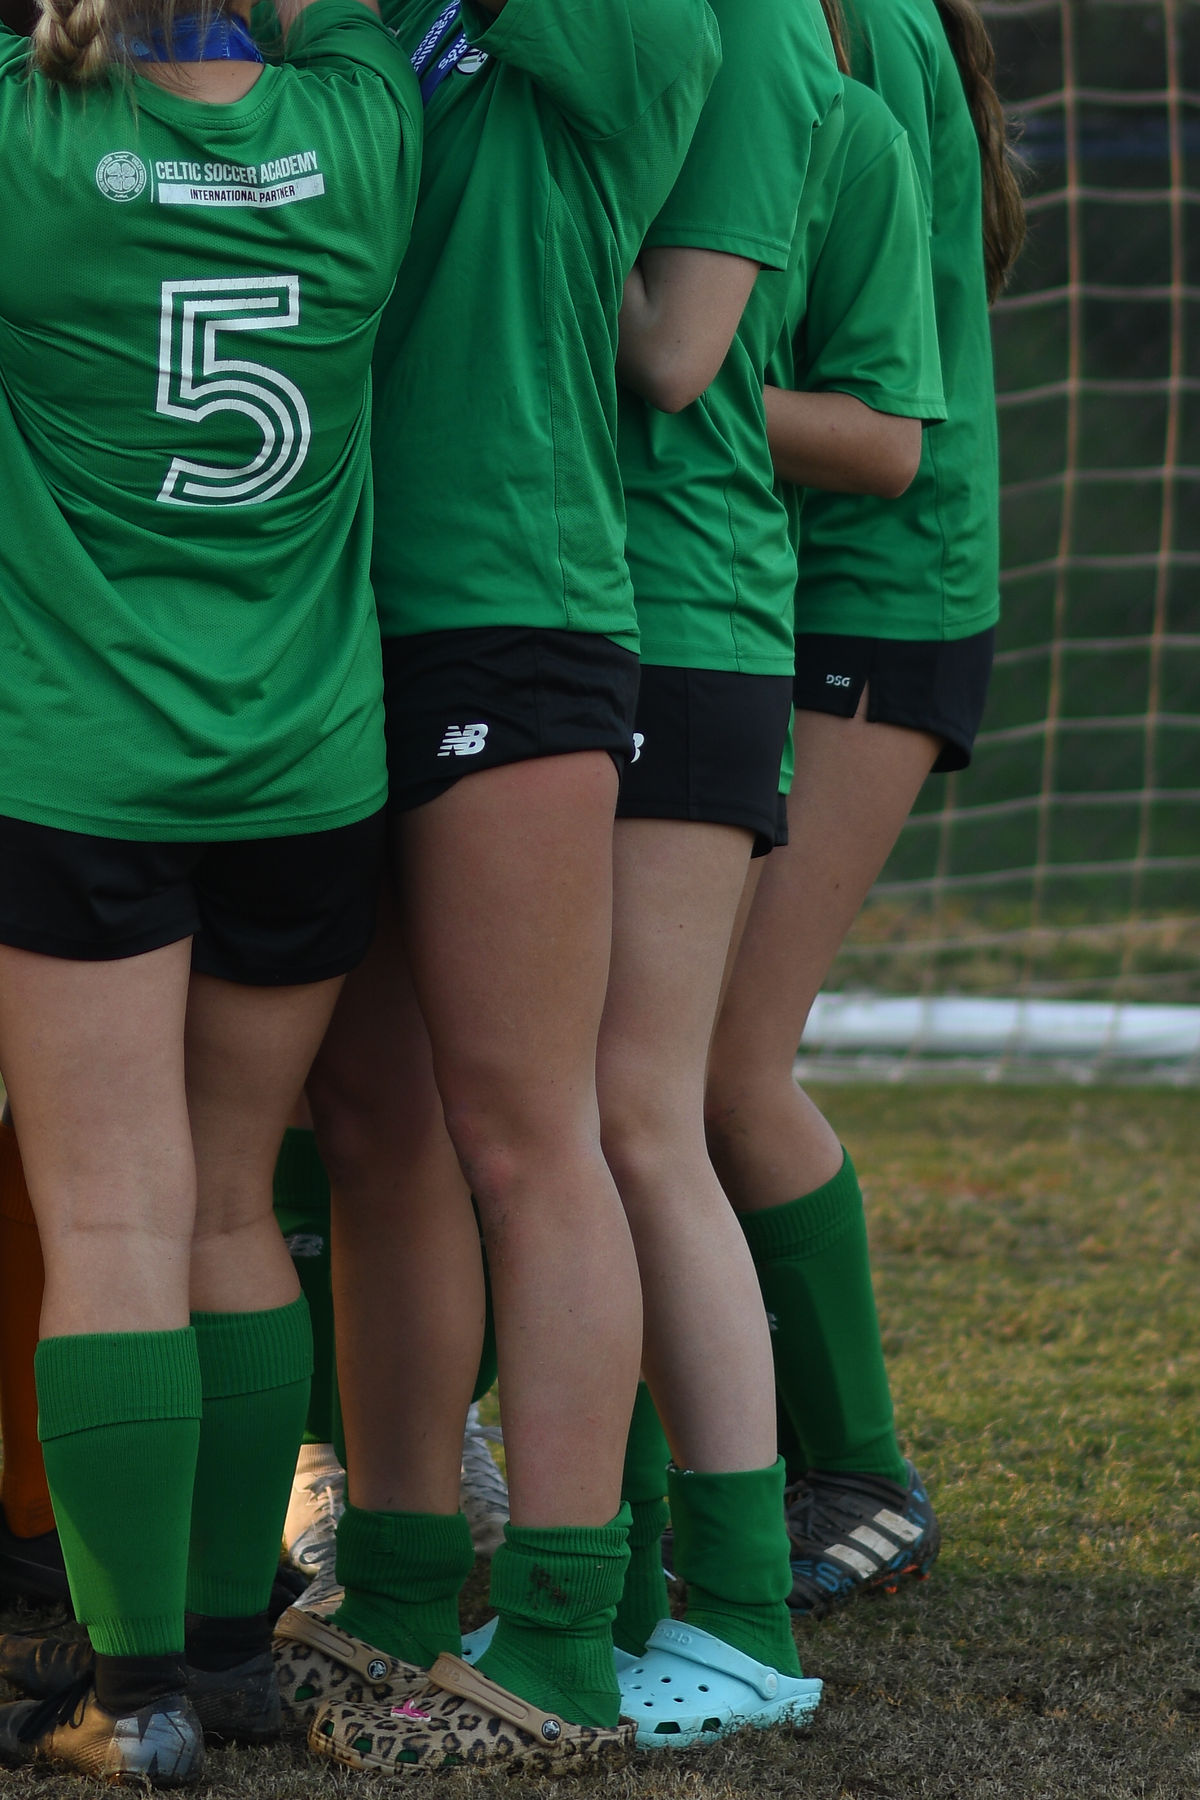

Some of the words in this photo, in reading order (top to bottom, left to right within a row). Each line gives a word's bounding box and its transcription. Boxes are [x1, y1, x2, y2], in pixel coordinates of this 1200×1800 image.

[155, 161, 201, 182] CELTIC
[204, 162, 258, 184] SOCCER
[260, 150, 318, 184] ACADEMY
[190, 188, 257, 202] INTERNATIONAL
[259, 184, 296, 203] PARTNER
[155, 274, 312, 508] 5
[825, 674, 851, 687] DSG
